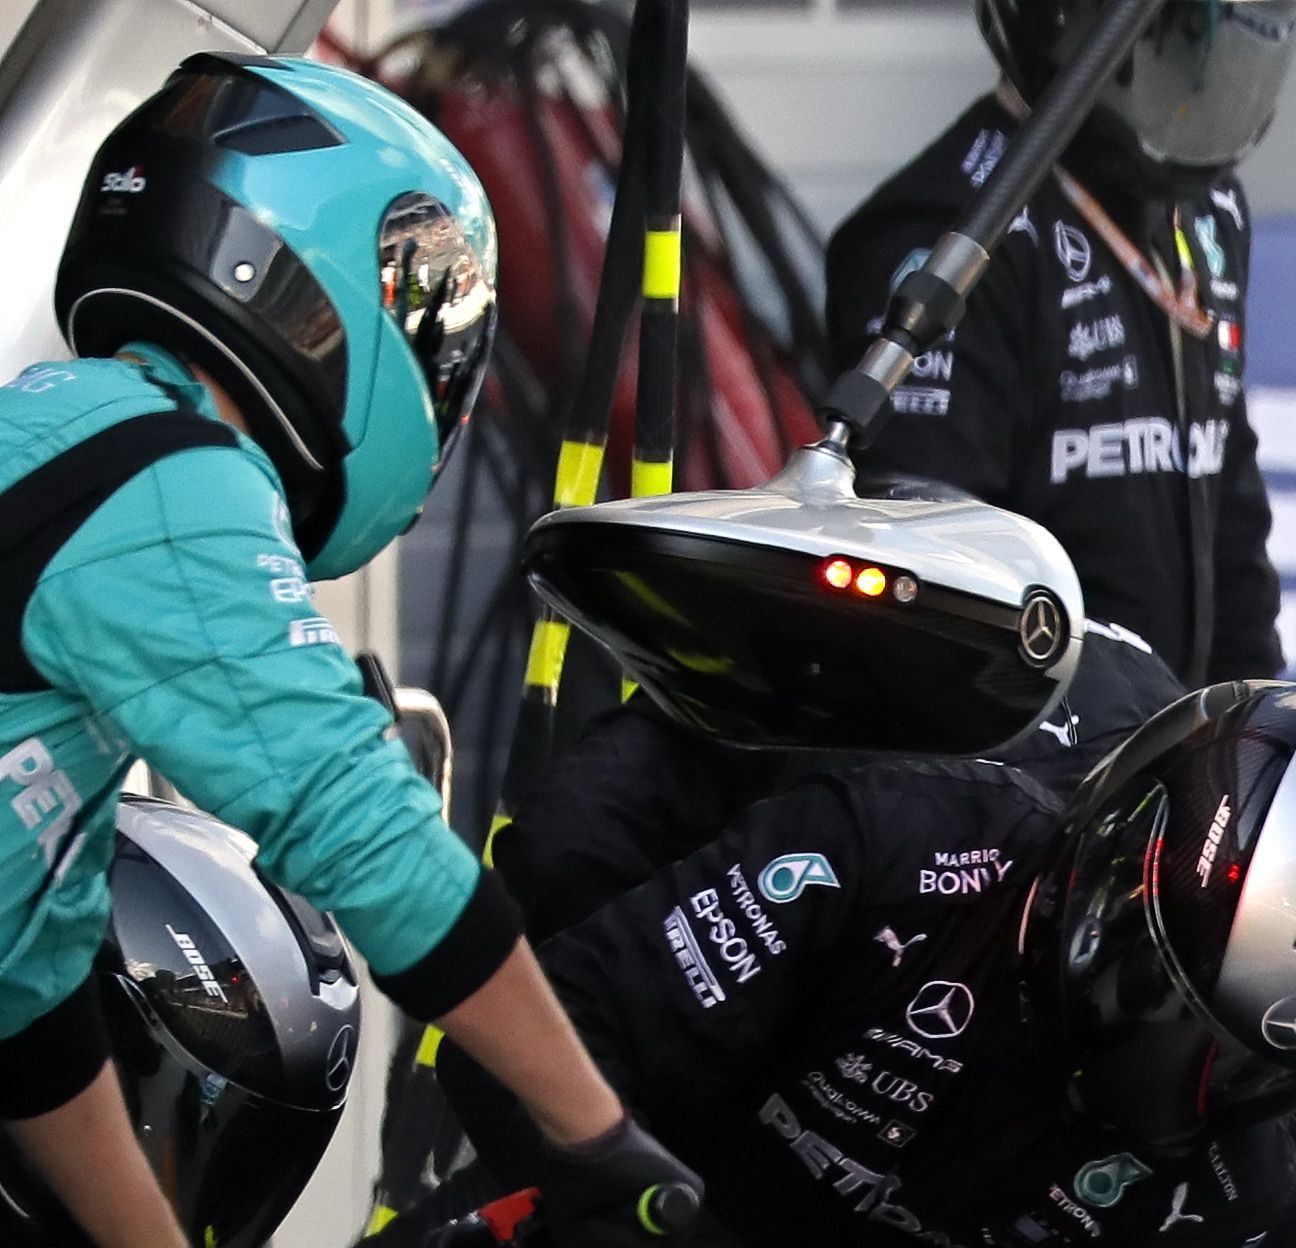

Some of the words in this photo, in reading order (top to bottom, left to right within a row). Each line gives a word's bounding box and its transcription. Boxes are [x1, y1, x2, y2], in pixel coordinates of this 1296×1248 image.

[1196, 794, 1231, 888] BOSE
[165, 923, 228, 1003] BOSE
[690, 887, 762, 983] EPSON
[873, 1071, 934, 1112] UBS
